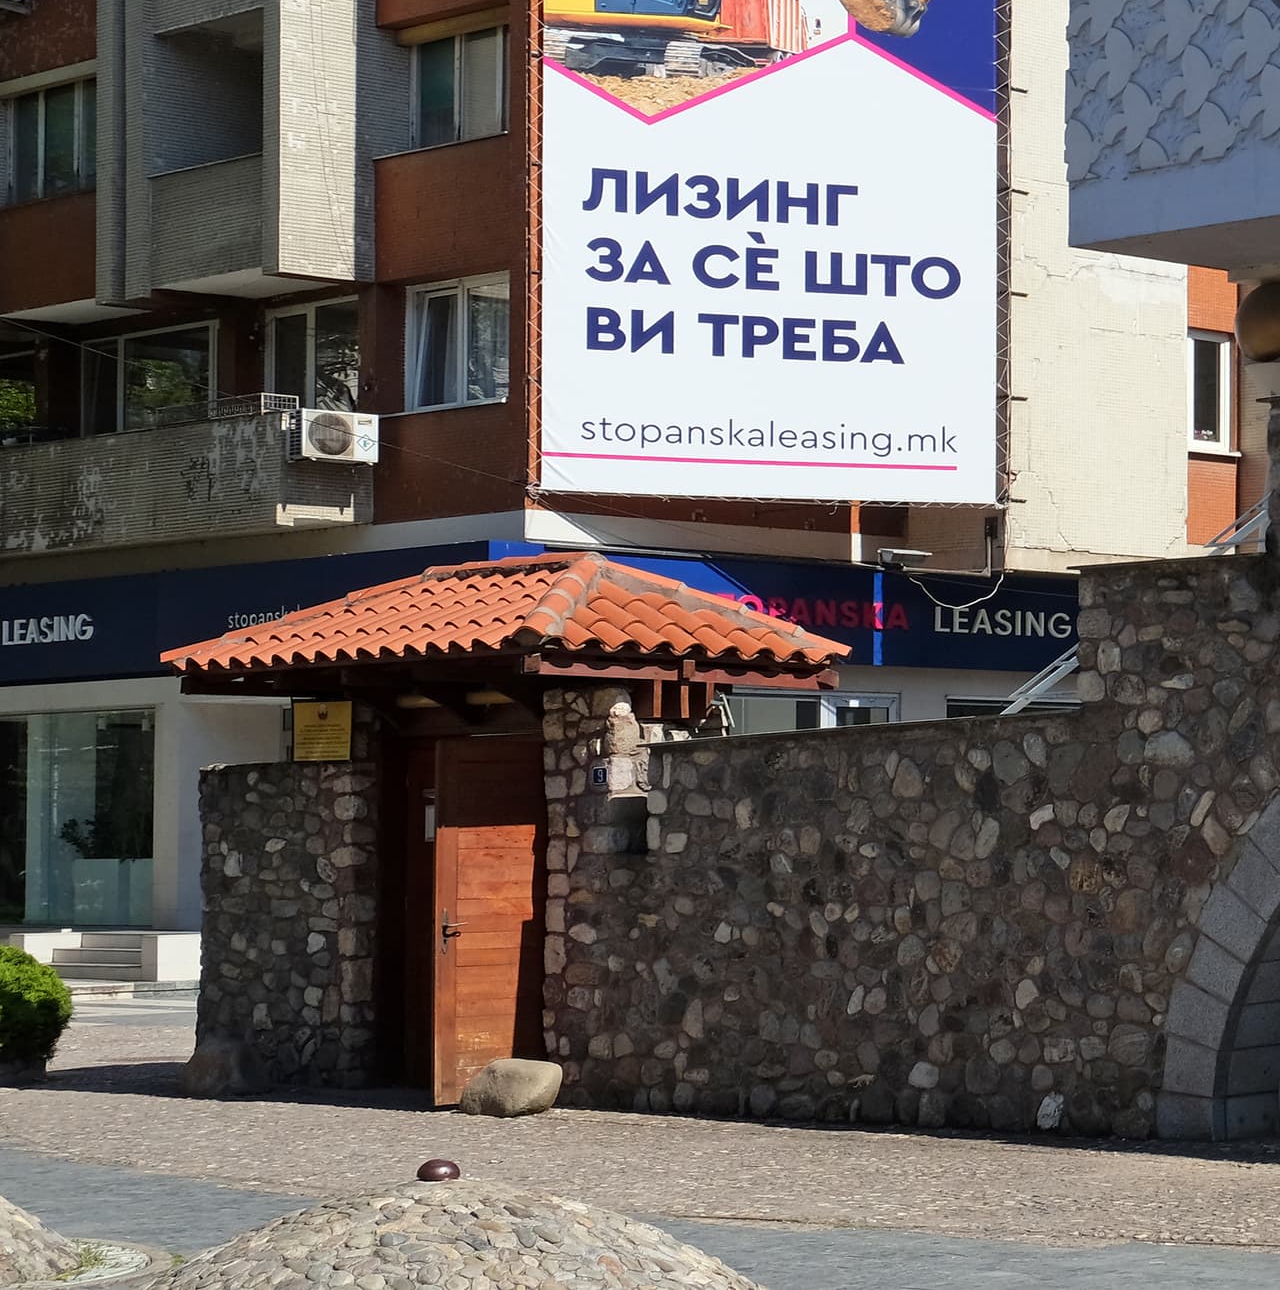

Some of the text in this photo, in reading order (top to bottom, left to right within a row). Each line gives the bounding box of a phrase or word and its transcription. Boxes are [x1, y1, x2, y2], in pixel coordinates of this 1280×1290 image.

[582, 168, 858, 226] ЛИЗИНГ
[585, 237, 671, 286] ЗА
[804, 251, 961, 300] ШТО
[586, 307, 905, 365] ВИ ТРЕБА
[580, 418, 958, 457] stopanskaleasing.mk
[2, 614, 94, 645] LEASING
[934, 606, 1072, 638] LEASING
